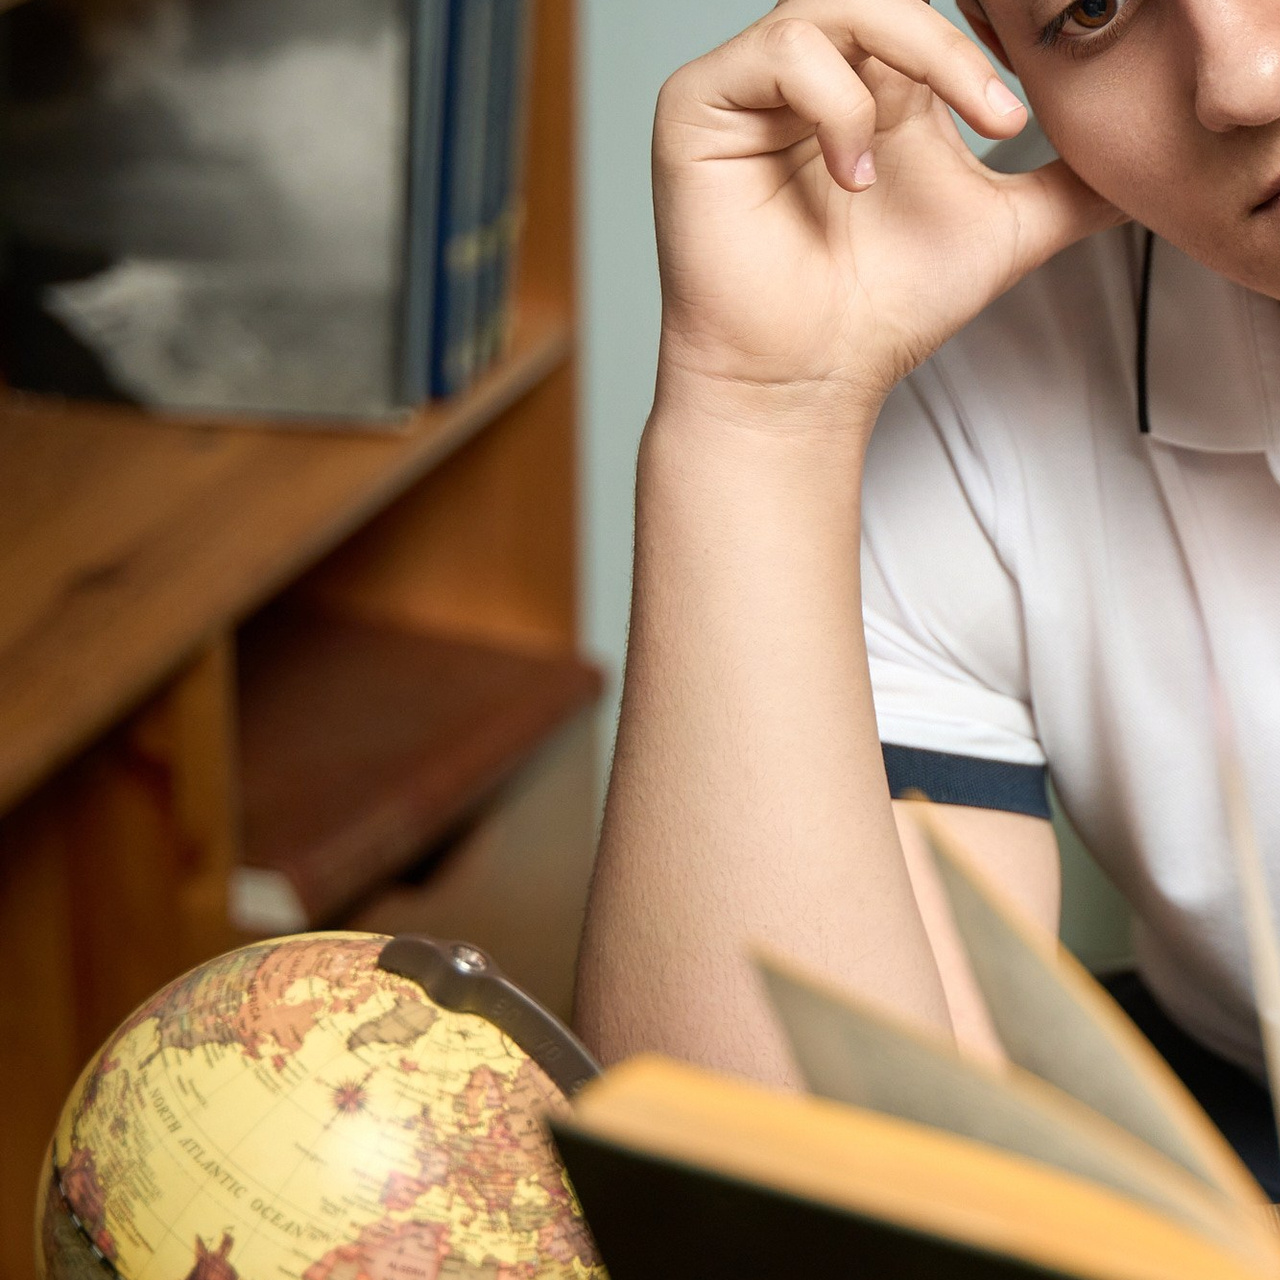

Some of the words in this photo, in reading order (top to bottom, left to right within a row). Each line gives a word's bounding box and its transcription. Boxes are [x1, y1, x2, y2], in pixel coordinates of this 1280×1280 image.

[150, 1087, 182, 1134] NORTH
[178, 1137, 248, 1200] ATLANTIC
[250, 1198, 304, 1238] OCEAN
[387, 1261, 427, 1277] ALGERIA
